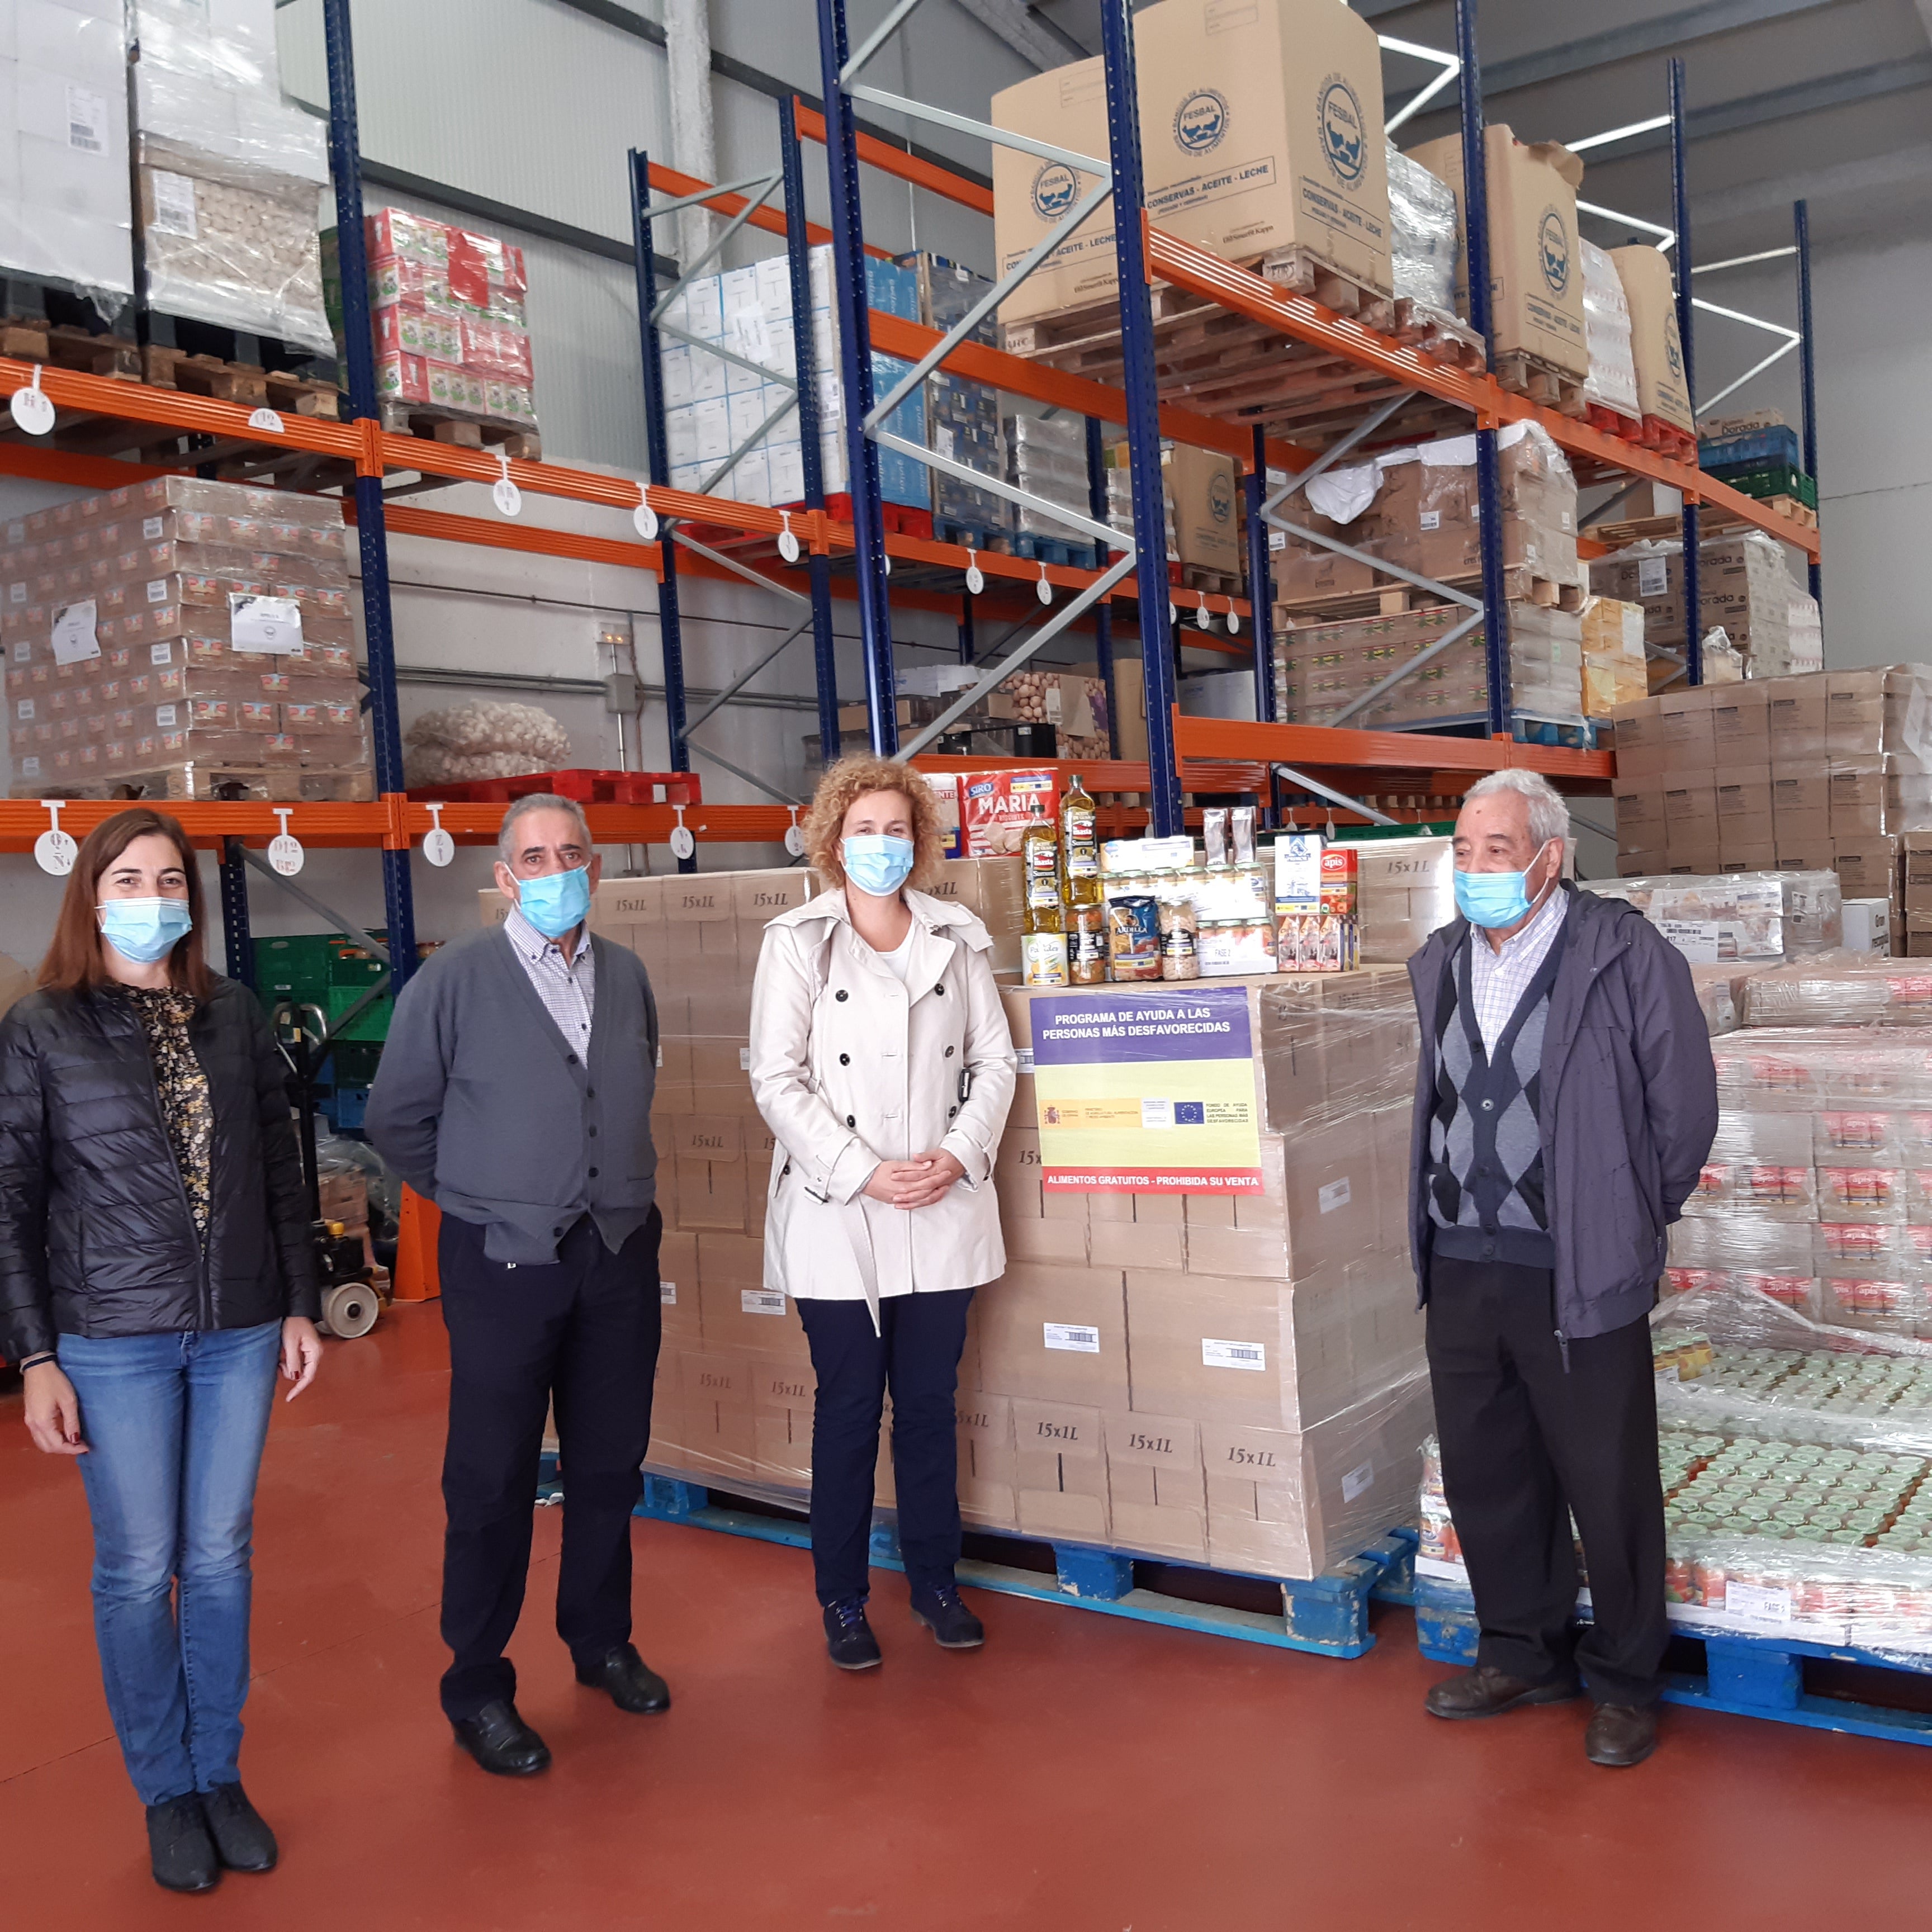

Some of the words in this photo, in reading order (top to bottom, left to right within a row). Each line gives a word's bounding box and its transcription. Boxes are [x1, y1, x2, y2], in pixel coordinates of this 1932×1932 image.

[1183, 105, 1216, 121] FESBAL
[1040, 174, 1069, 188] FESBAL
[1147, 187, 1195, 209] CONSERVAS
[1201, 176, 1233, 191] ACEITE
[1239, 164, 1269, 180] LECHE
[1055, 242, 1084, 257] ACEITE
[1090, 234, 1117, 247] LECHE
[1722, 422, 1760, 435] Dorada
[1700, 556, 1732, 566] orada
[1700, 594, 1734, 605] orada
[970, 783, 992, 795] SIRO
[978, 793, 1040, 815] MARIA
[1324, 857, 1343, 869] apis
[1386, 860, 1430, 874] 15x1L
[615, 899, 647, 912] 15x1L
[681, 896, 714, 909] 15x1L
[753, 893, 788, 907] 15x1L
[1115, 925, 1147, 934] ARDILLA
[1055, 1012, 1117, 1025] PROGRAMA
[1118, 1011, 1134, 1022] DE
[1135, 1010, 1175, 1021] AYUDA
[1177, 1009, 1186, 1019] A
[1187, 1007, 1211, 1019] LAS
[1042, 1026, 1101, 1040] PERSONAS
[1102, 1024, 1126, 1038] MÁS
[1127, 1021, 1230, 1036] DESFAVORECIDAS
[692, 1135, 723, 1148] 15x1L
[1047, 1175, 1097, 1185] ALIMENTOS
[1098, 1175, 1149, 1185] GRATUITOS
[1156, 1176, 1208, 1186] PROHIBIDA
[1209, 1176, 1224, 1186] SU
[1225, 1176, 1259, 1186] VENTA
[700, 1372, 732, 1389] 15x1L
[771, 1381, 806, 1397] 15x1L
[957, 1410, 989, 1427] 5x1L
[1037, 1422, 1078, 1441] 15x1L
[1128, 1433, 1173, 1453] 15x1L
[1227, 1446, 1276, 1467] 15x1L
